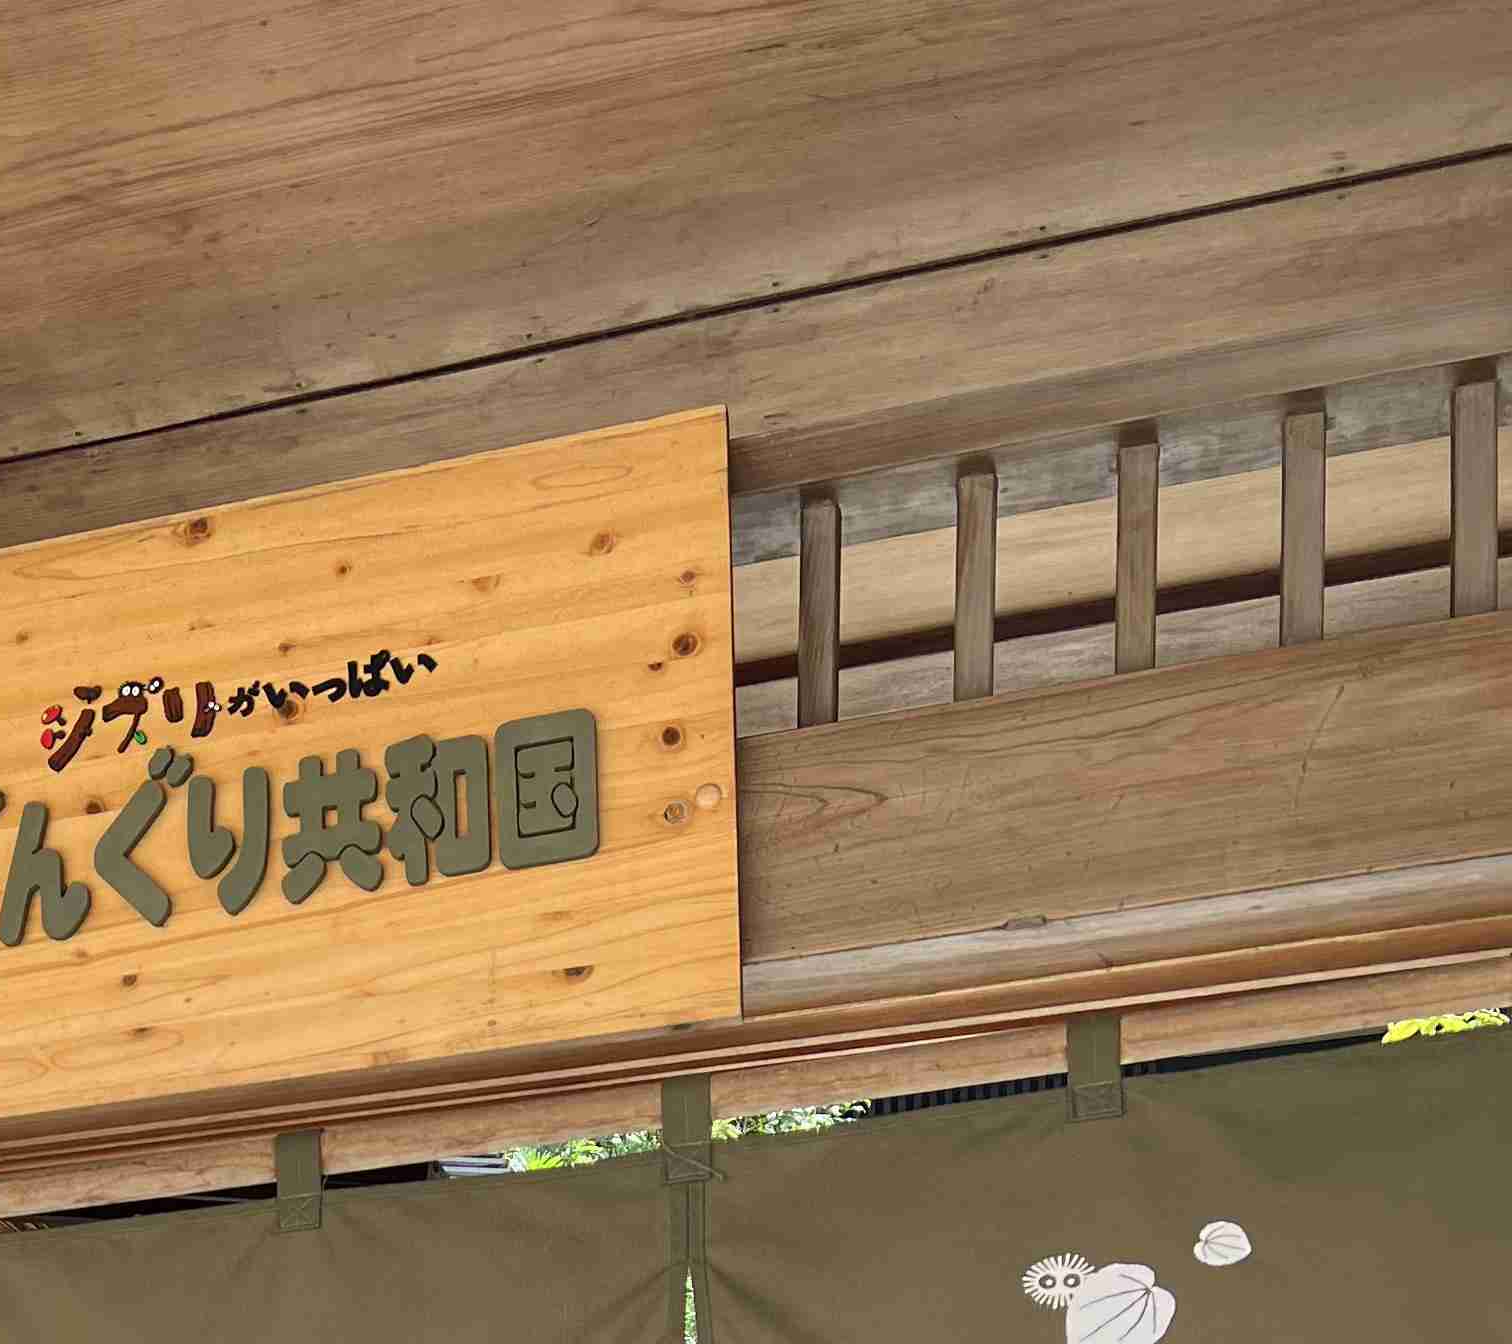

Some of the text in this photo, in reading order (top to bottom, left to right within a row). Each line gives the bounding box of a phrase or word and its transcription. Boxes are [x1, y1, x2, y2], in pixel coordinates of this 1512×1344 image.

[40, 648, 438, 773] ジブリがいっぱい
